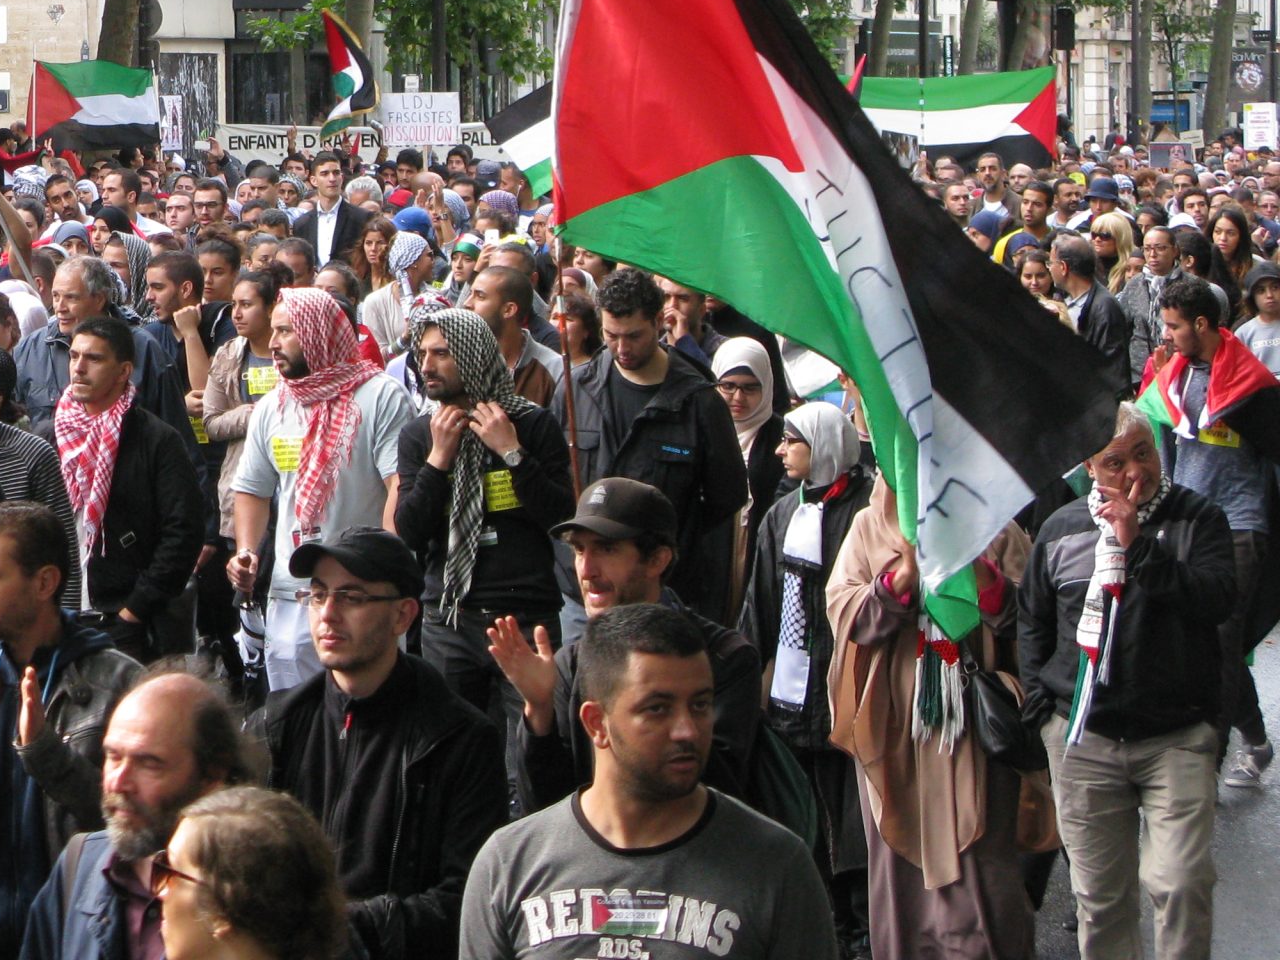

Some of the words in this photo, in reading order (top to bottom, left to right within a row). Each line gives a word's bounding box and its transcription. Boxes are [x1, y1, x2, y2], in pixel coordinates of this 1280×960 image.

[401, 95, 434, 110] LDJ
[388, 111, 453, 124] FASCISTES
[384, 124, 452, 142] DISSOLUTION
[228, 134, 288, 151] ENFANT
